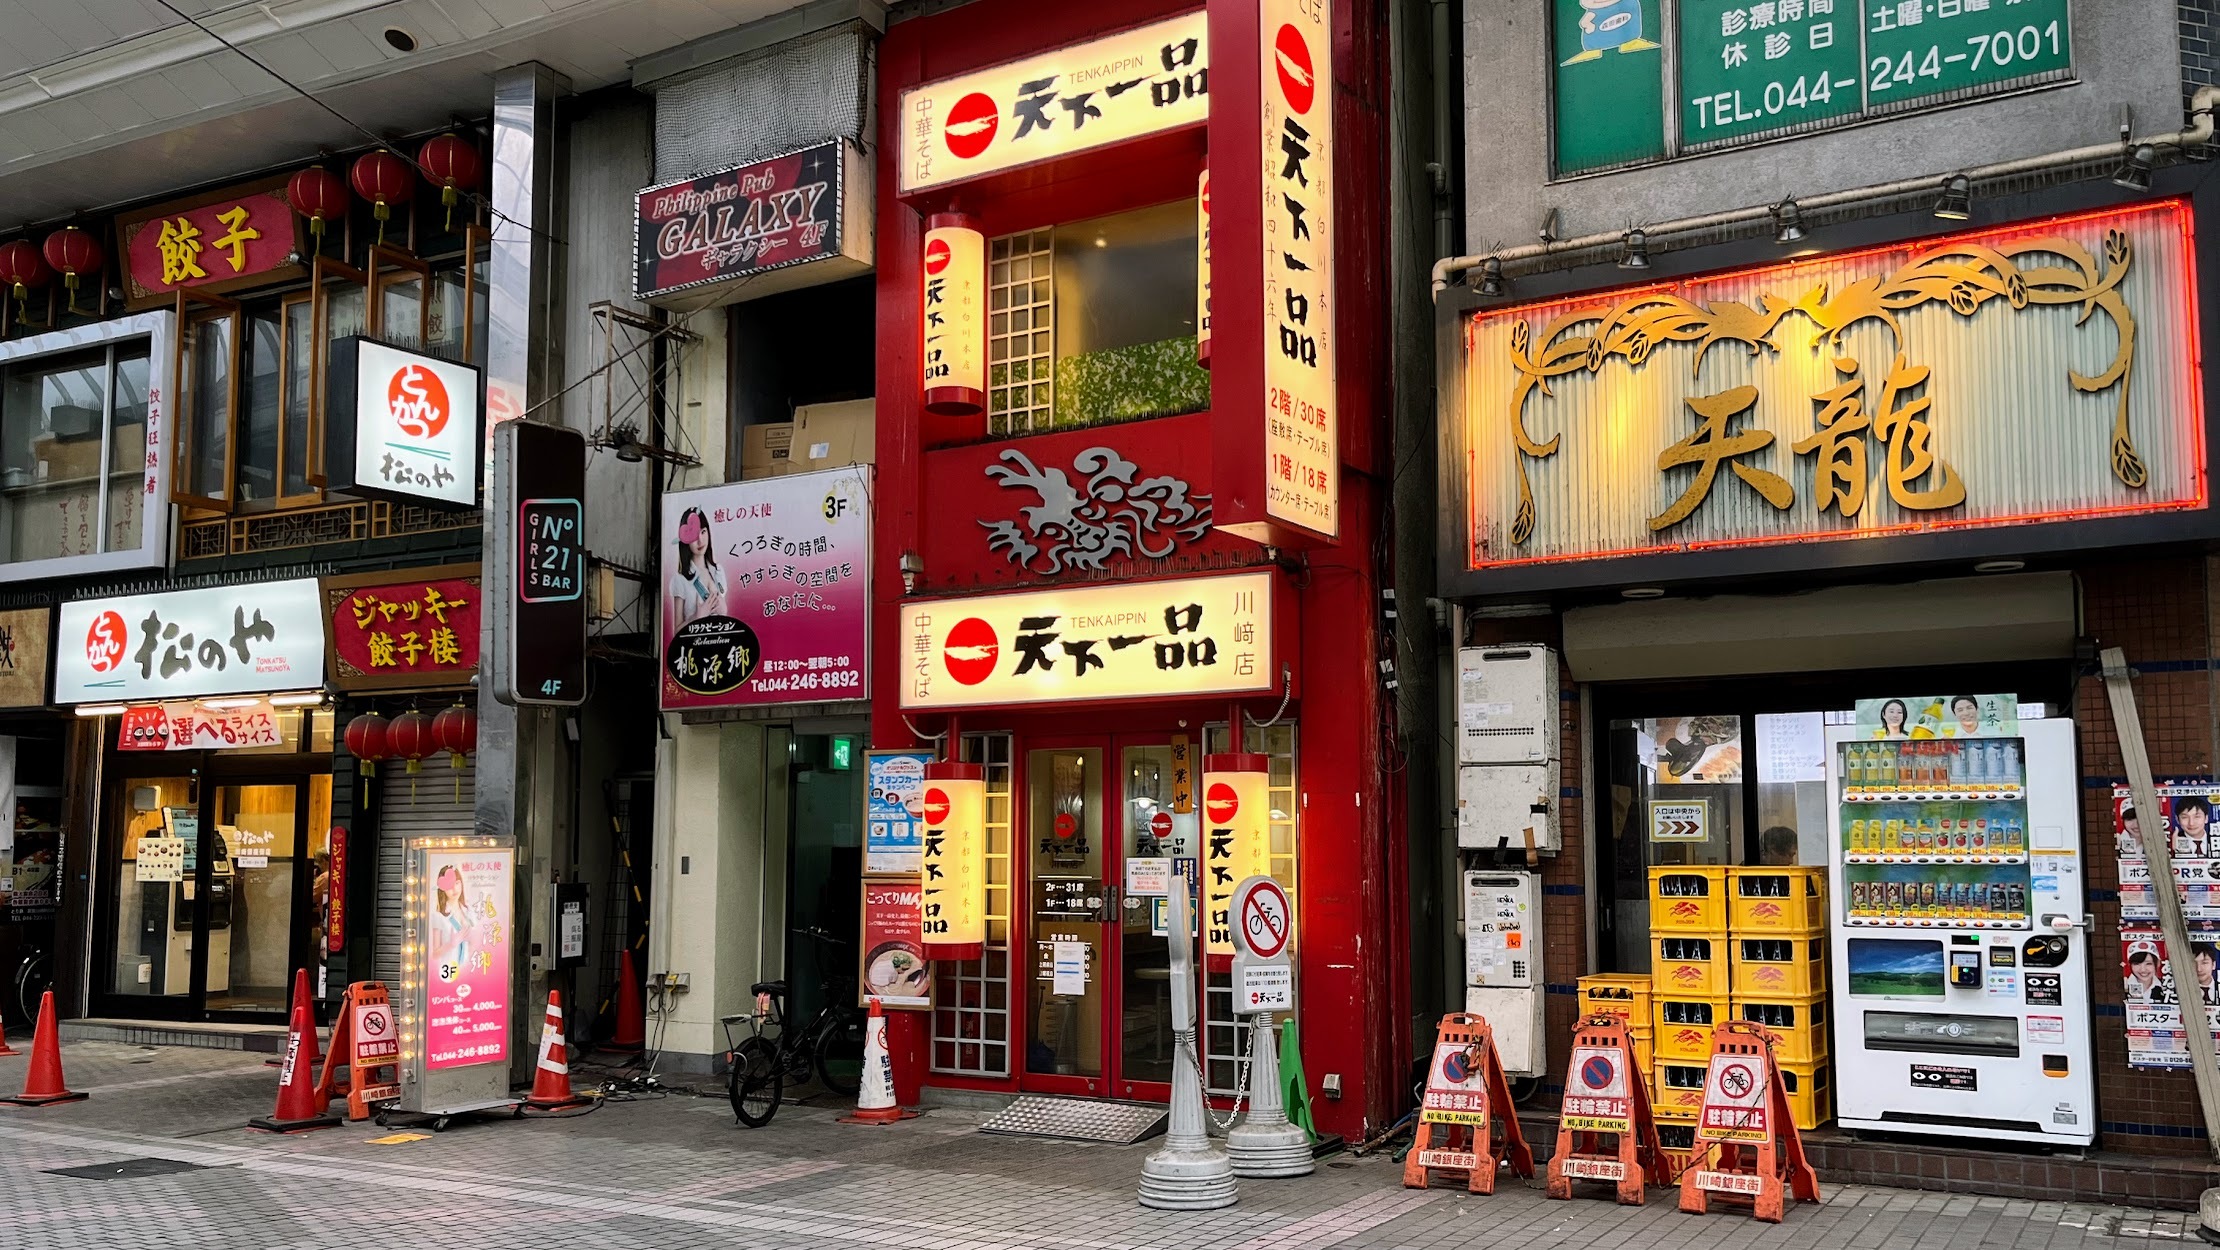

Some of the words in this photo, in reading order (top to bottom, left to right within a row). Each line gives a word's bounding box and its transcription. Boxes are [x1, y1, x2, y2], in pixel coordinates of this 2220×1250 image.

[1720, 0, 1834, 37] 診療時間
[1010, 37, 1209, 143] 天下一品
[1068, 55, 1145, 86] TENKAIPPIN
[914, 95, 933, 181] 中華そば
[652, 183, 739, 220] Philippine
[740, 166, 776, 198] Pub
[657, 181, 828, 260] GALAXY
[154, 204, 261, 286] 餃子
[700, 236, 789, 271] ギャラクシー
[799, 219, 829, 248] 4F
[1278, 114, 1318, 369] 天下一品
[924, 276, 950, 381] 天下一品
[1269, 386, 1327, 434] 2階/30席
[1648, 352, 1966, 532] 天龍
[378, 450, 456, 489] 松のや
[1271, 451, 1328, 497] 1階/18席
[713, 502, 773, 523] 癒しの天使
[824, 494, 848, 521] 3F
[528, 512, 540, 586] GIRLS
[540, 546, 570, 572] 21
[541, 574, 572, 591] BAR
[738, 561, 854, 590] やすらぎの空間を
[352, 586, 469, 630] ジャッキー
[687, 620, 737, 635] リラクゼーション
[1070, 611, 1148, 630] TENKAIPPIN
[133, 604, 276, 681] 松のや
[367, 627, 463, 668] 餃子楼
[913, 611, 932, 700] 中華そば
[1011, 602, 1218, 678] 天下一品
[673, 643, 751, 686] 桃源郷
[540, 678, 563, 697] 4F
[172, 716, 237, 747] 選べる
[230, 712, 272, 730] ライス
[236, 728, 275, 745] サイズ
[1172, 743, 1189, 809] 営業中
[331, 843, 343, 936] ジャッキー餃子楼
[922, 828, 948, 935] 天下一品
[1209, 828, 1235, 944] 天下一品
[440, 964, 458, 980] 3F
[359, 1041, 398, 1057] 駐輪禁止
[1425, 1092, 1482, 1112] 駐輪禁止
[1454, 1114, 1482, 1125] PARKING
[1564, 1097, 1628, 1118] 駐輪禁止
[1706, 1107, 1764, 1129] 駐輪禁止
[1597, 1120, 1627, 1130] PARKING
[1732, 1131, 1763, 1139] PARKING
